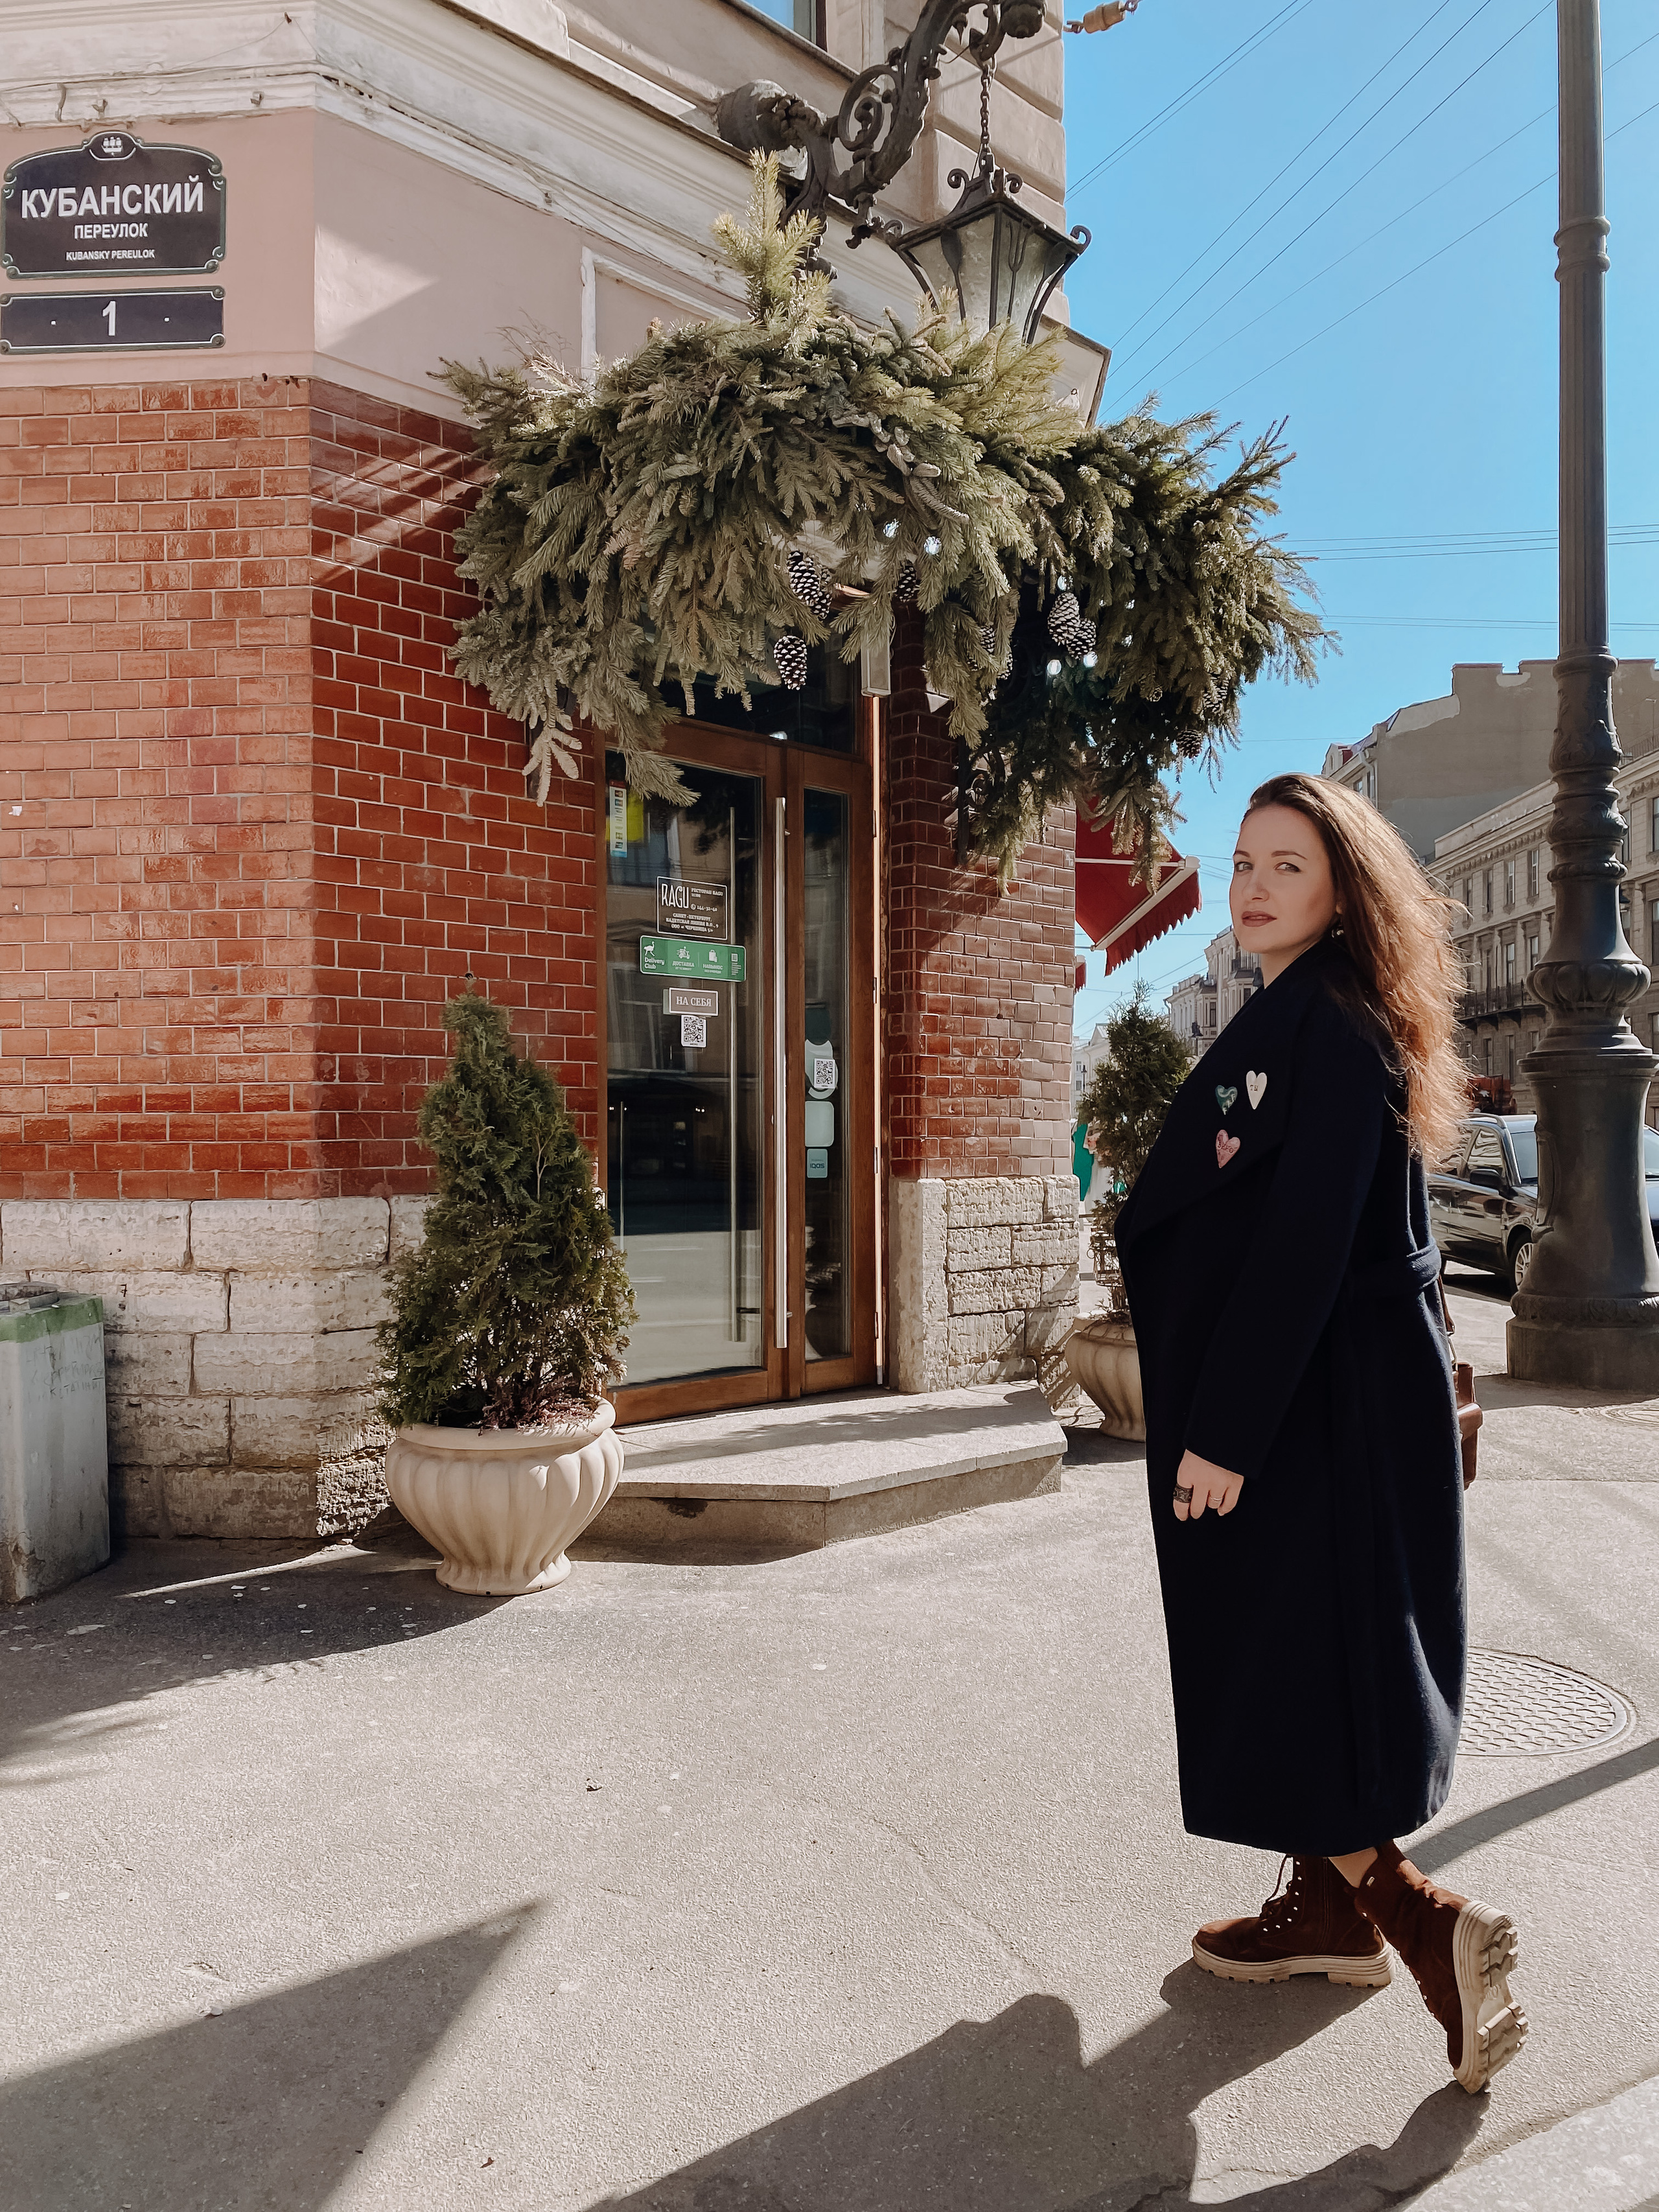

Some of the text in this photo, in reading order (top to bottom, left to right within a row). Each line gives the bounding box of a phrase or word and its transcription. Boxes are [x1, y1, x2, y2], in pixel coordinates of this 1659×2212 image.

[21, 174, 204, 219] КУБАНСКИЙ
[74, 223, 149, 240] ПЕРЕУЛОК
[65, 249, 156, 261] KUBANSKY PEREULOK
[102, 300, 117, 336] 1
[661, 883, 689, 909] RAGU
[644, 957, 665, 966] Delivery
[676, 996, 712, 1007] НА СЕБЯ
